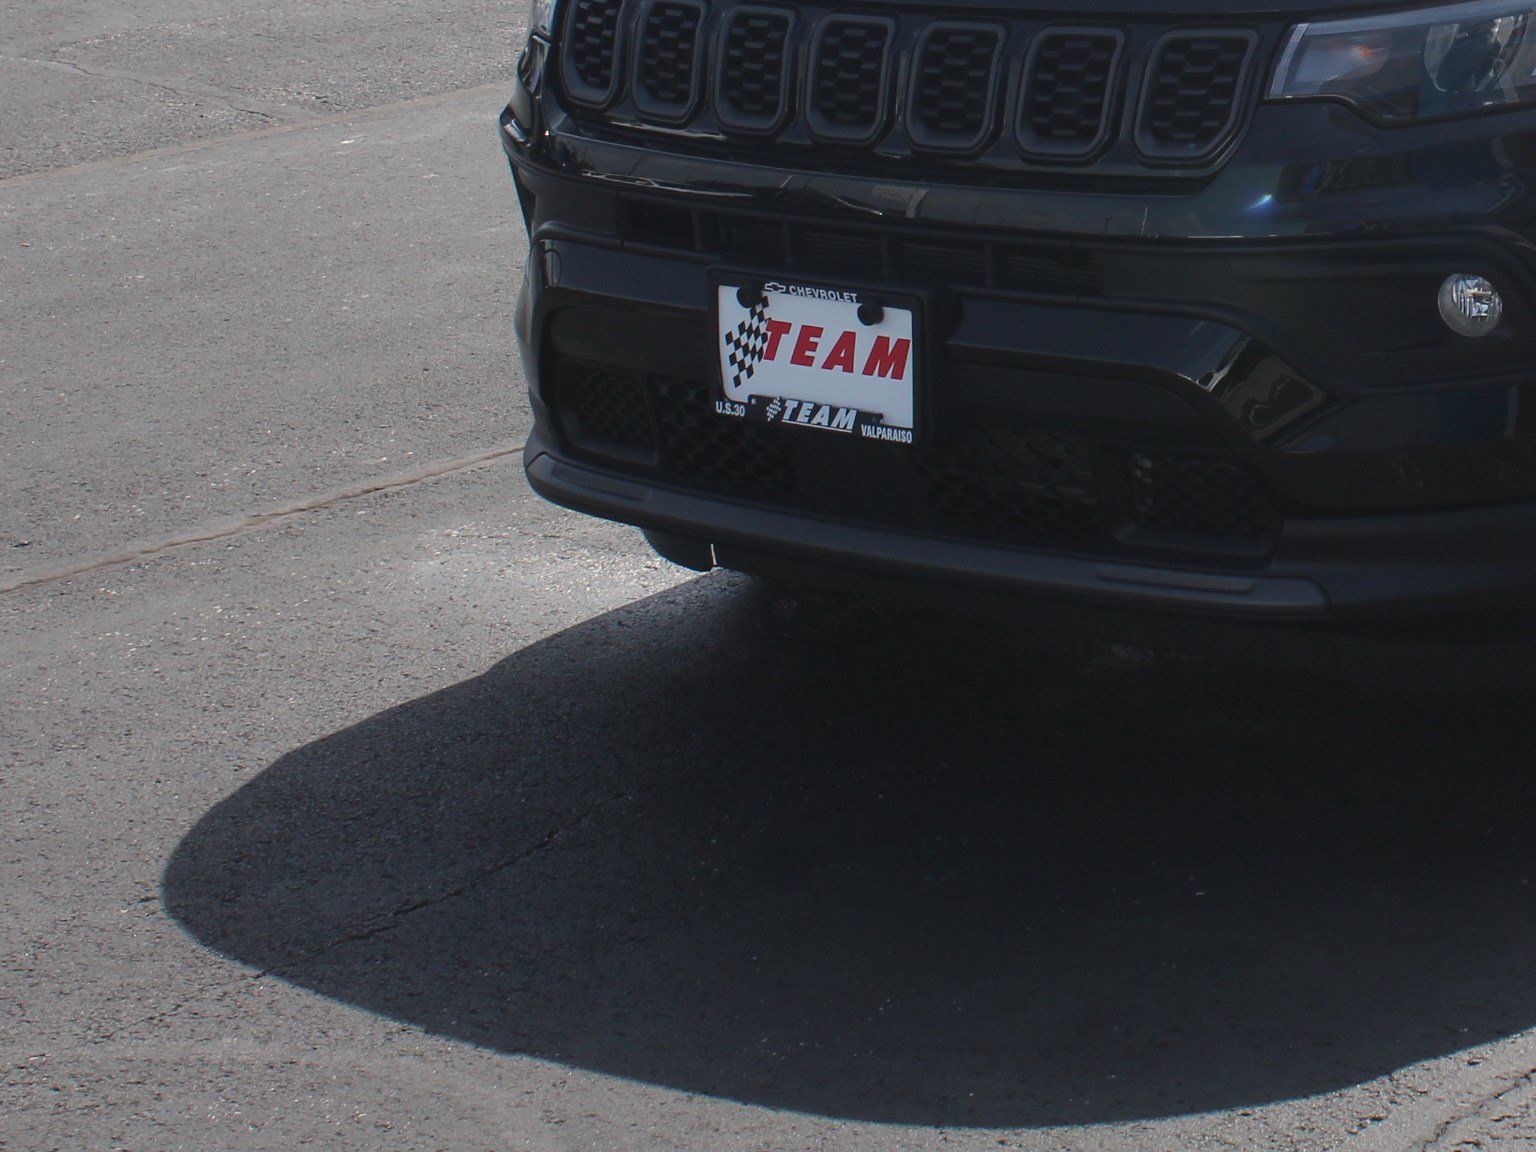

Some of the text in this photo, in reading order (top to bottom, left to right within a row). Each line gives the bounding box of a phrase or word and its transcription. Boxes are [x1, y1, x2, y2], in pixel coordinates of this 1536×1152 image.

[788, 285, 858, 304] CHEVROLET
[763, 320, 911, 380] TEAM
[781, 399, 857, 430] TEAM
[861, 424, 913, 444] VALPARAISO
